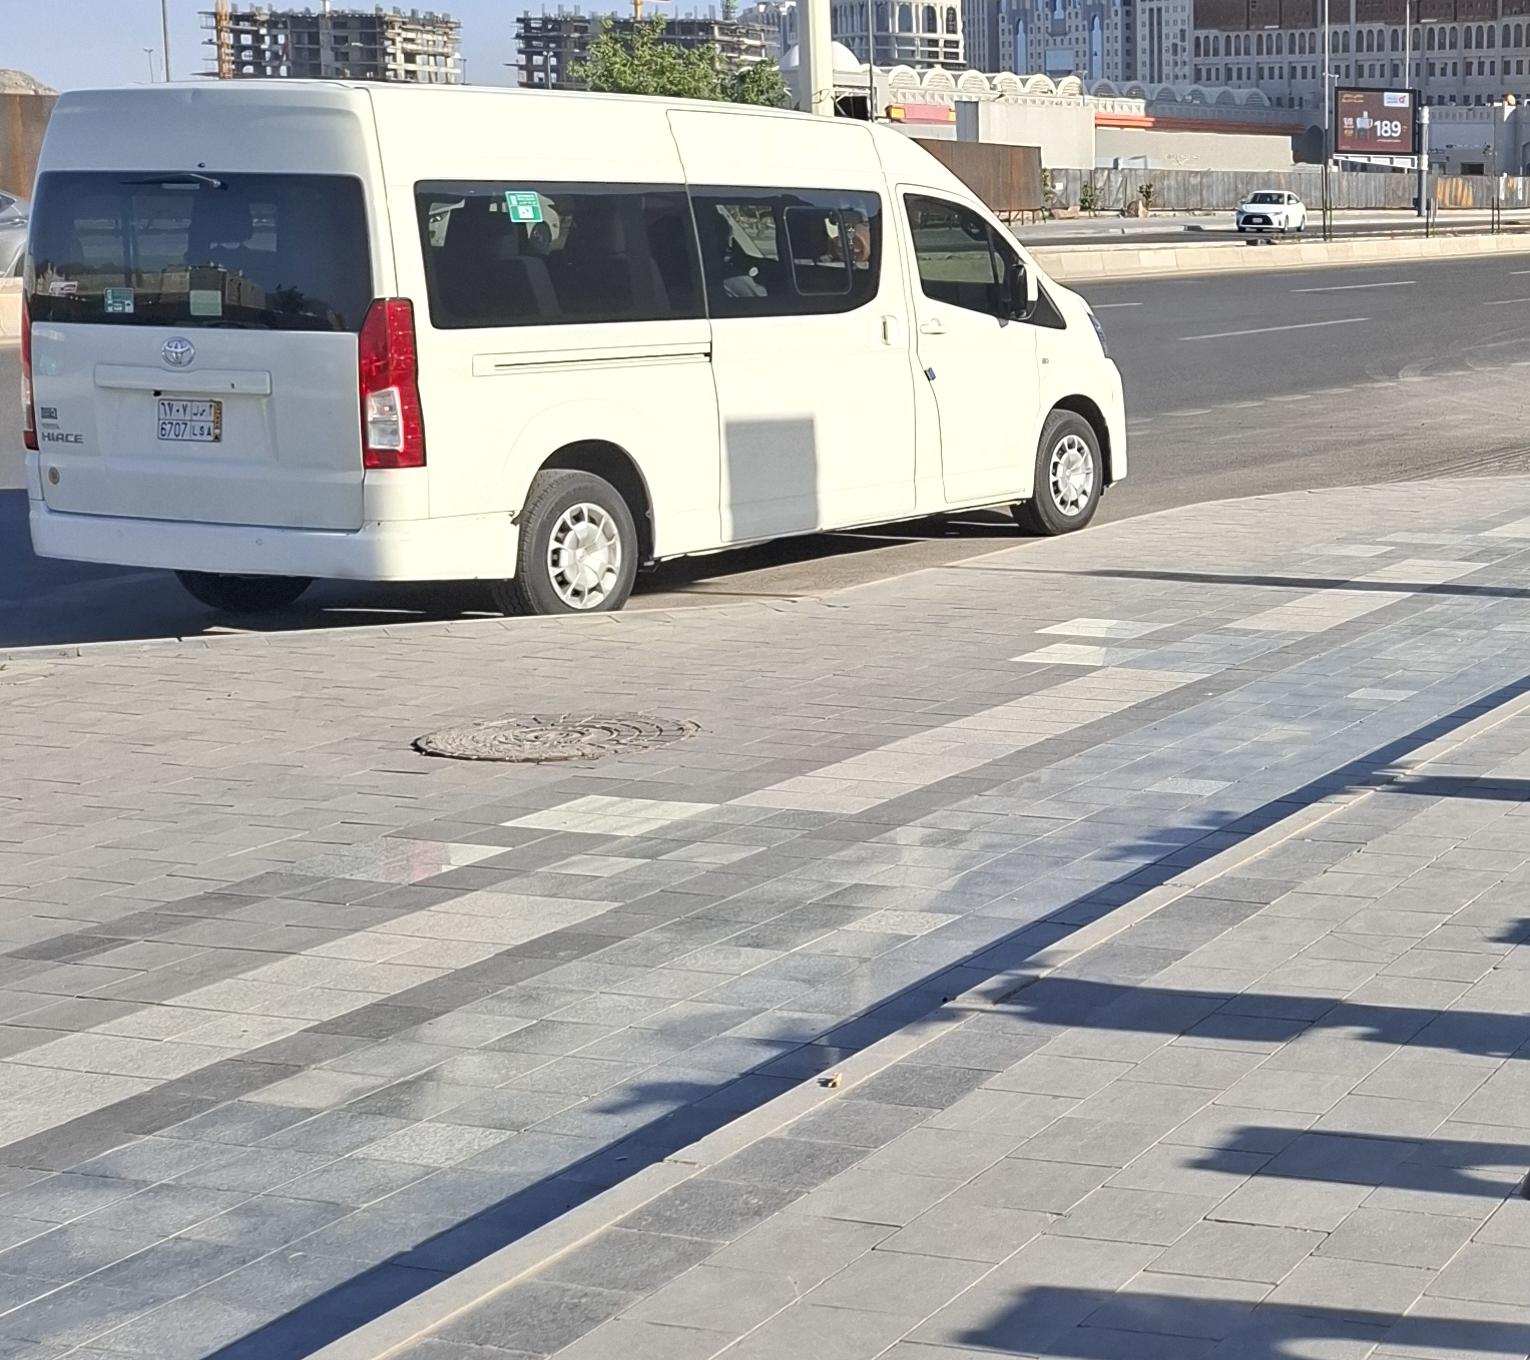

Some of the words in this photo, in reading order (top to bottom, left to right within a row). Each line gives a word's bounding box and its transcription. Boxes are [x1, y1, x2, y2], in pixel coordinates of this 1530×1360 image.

[1374, 120, 1402, 137] 189
[41, 432, 84, 444] HIACE
[160, 421, 188, 438] 6707
